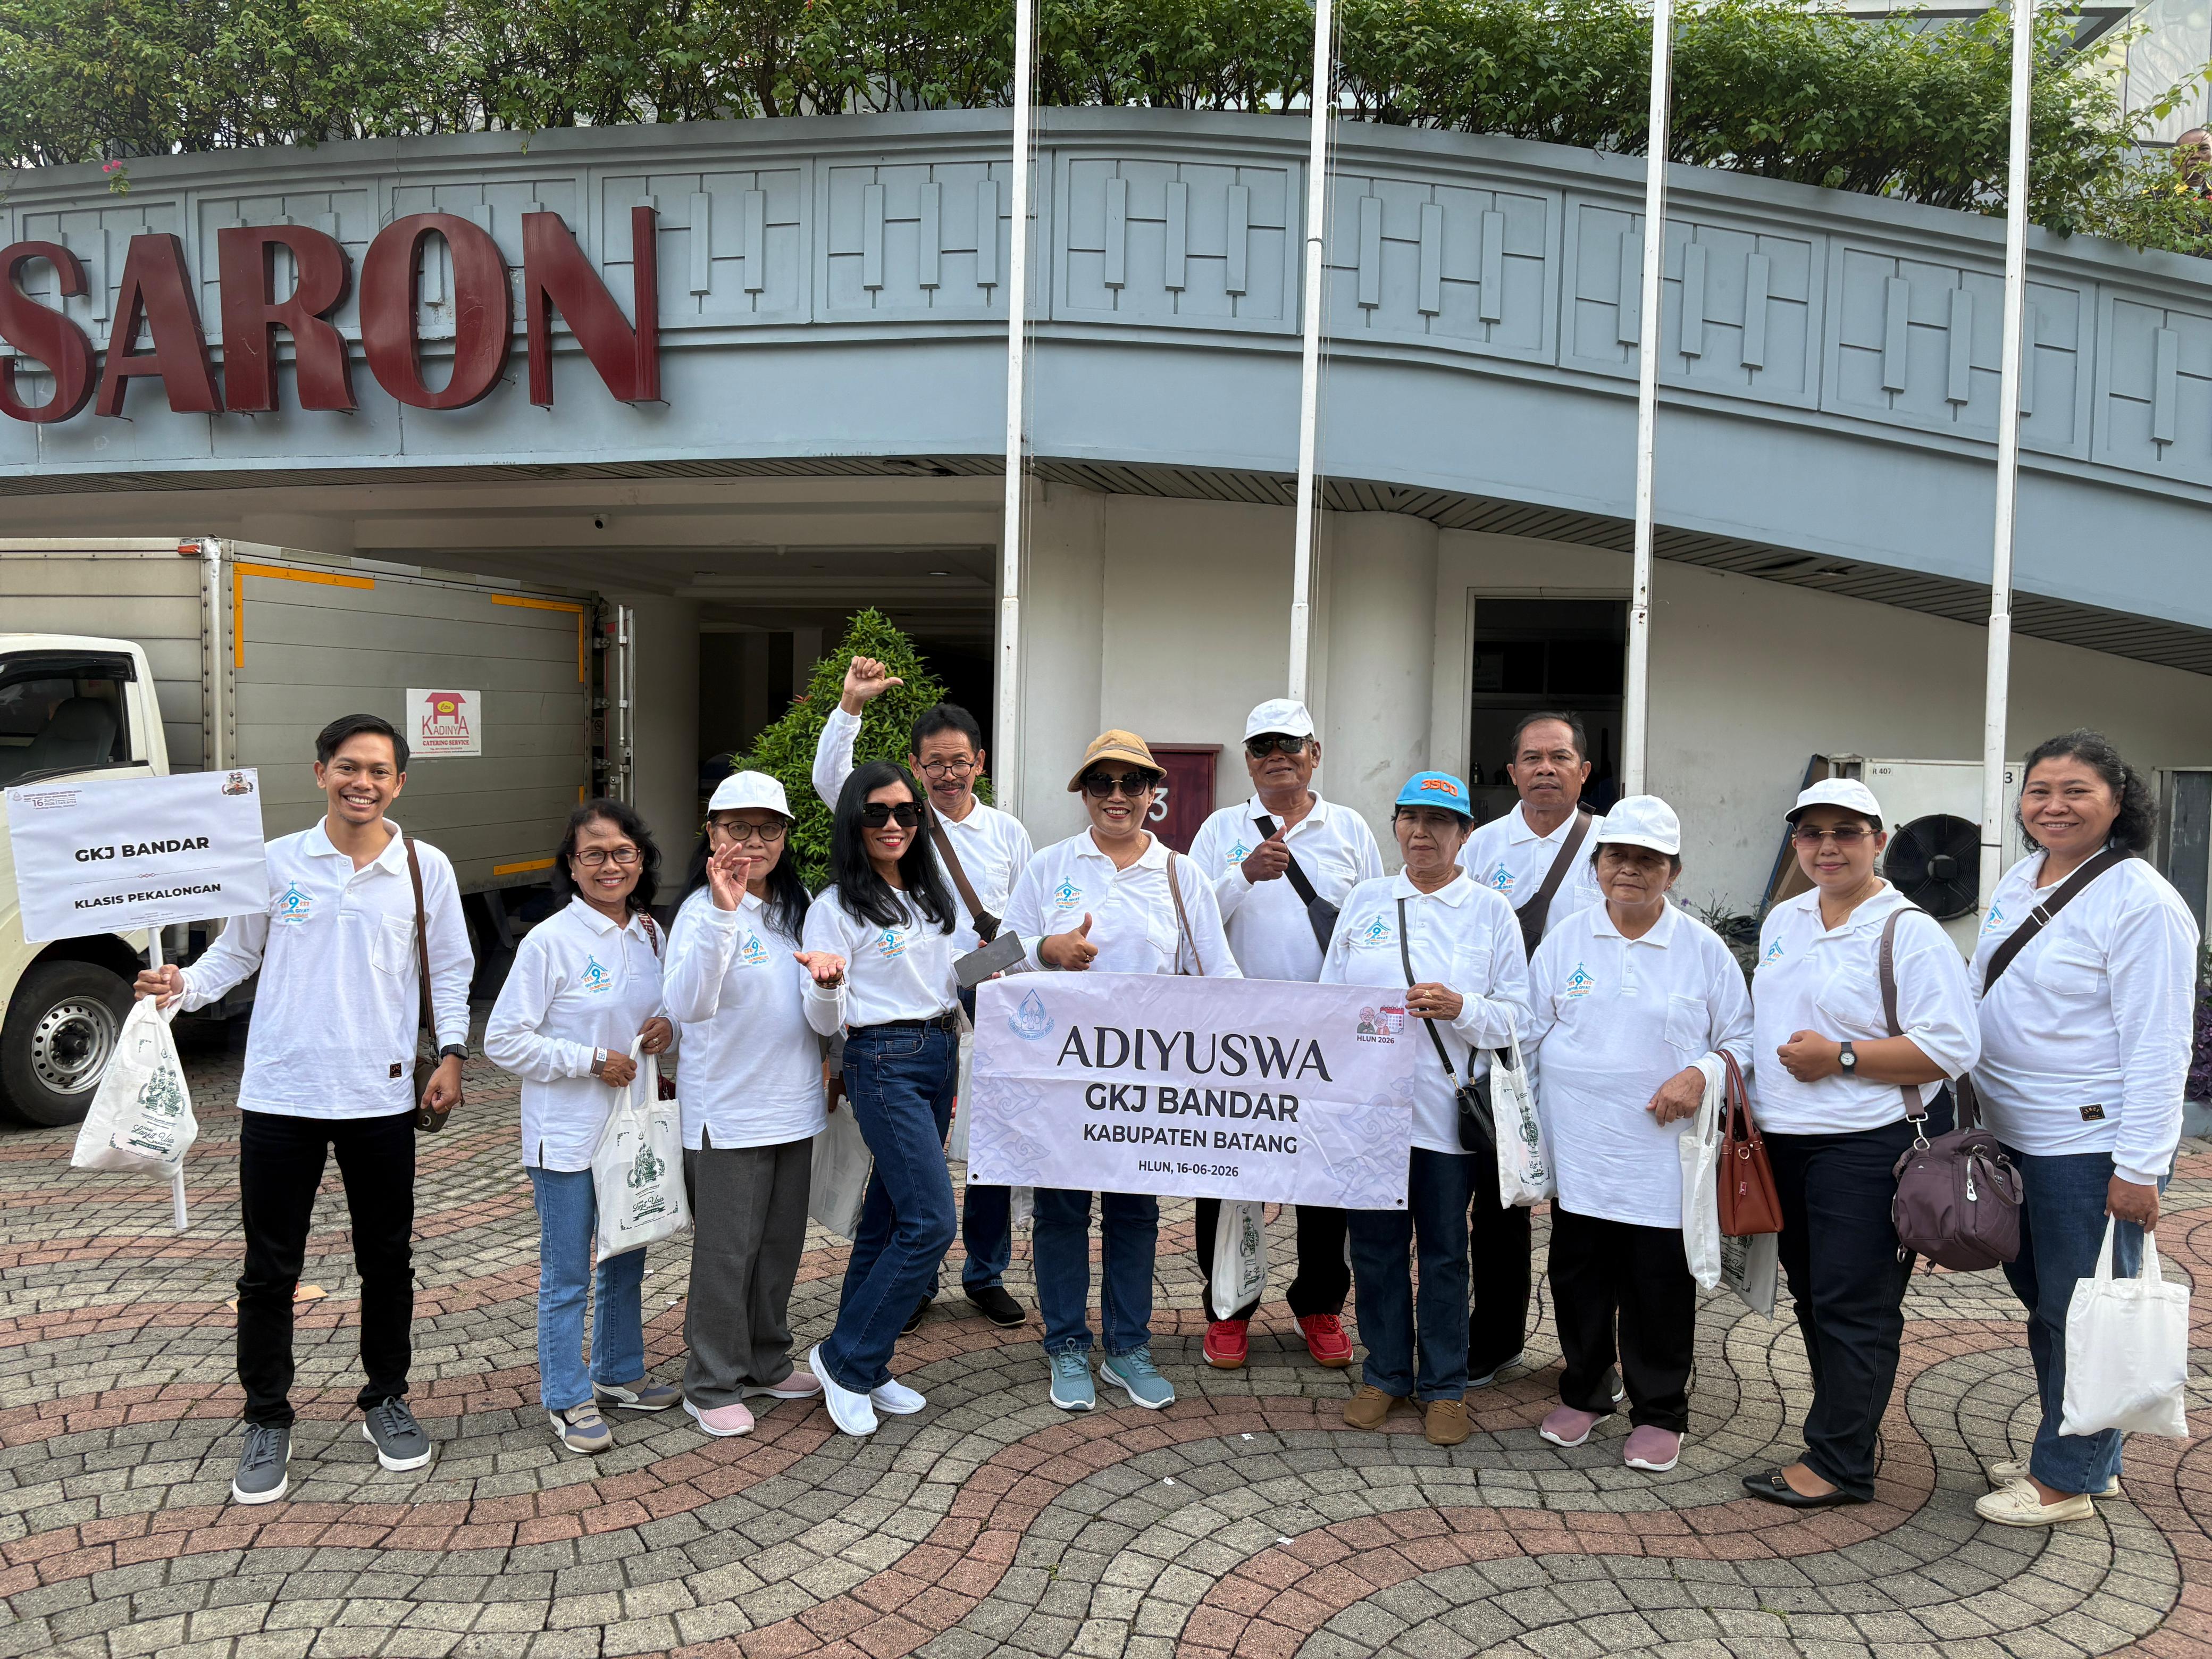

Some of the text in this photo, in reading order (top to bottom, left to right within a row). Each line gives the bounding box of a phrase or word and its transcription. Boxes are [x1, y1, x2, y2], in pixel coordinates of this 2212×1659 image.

[0, 206, 660, 423] SARON
[422, 715, 469, 735] KADINYA
[2005, 772, 2013, 784] 3
[1149, 787, 1168, 822] 3
[75, 837, 210, 862] GKJ BANDAR
[75, 884, 221, 909] KLASIS PEKALONGAN
[1058, 1026, 1333, 1082] ADIYUSWA
[1085, 1083, 1299, 1122] GKJ BANDAR
[1084, 1124, 1297, 1154] KABUPATEN BATANG
[1139, 1160, 1239, 1177] HLUN, 16-06-2026
